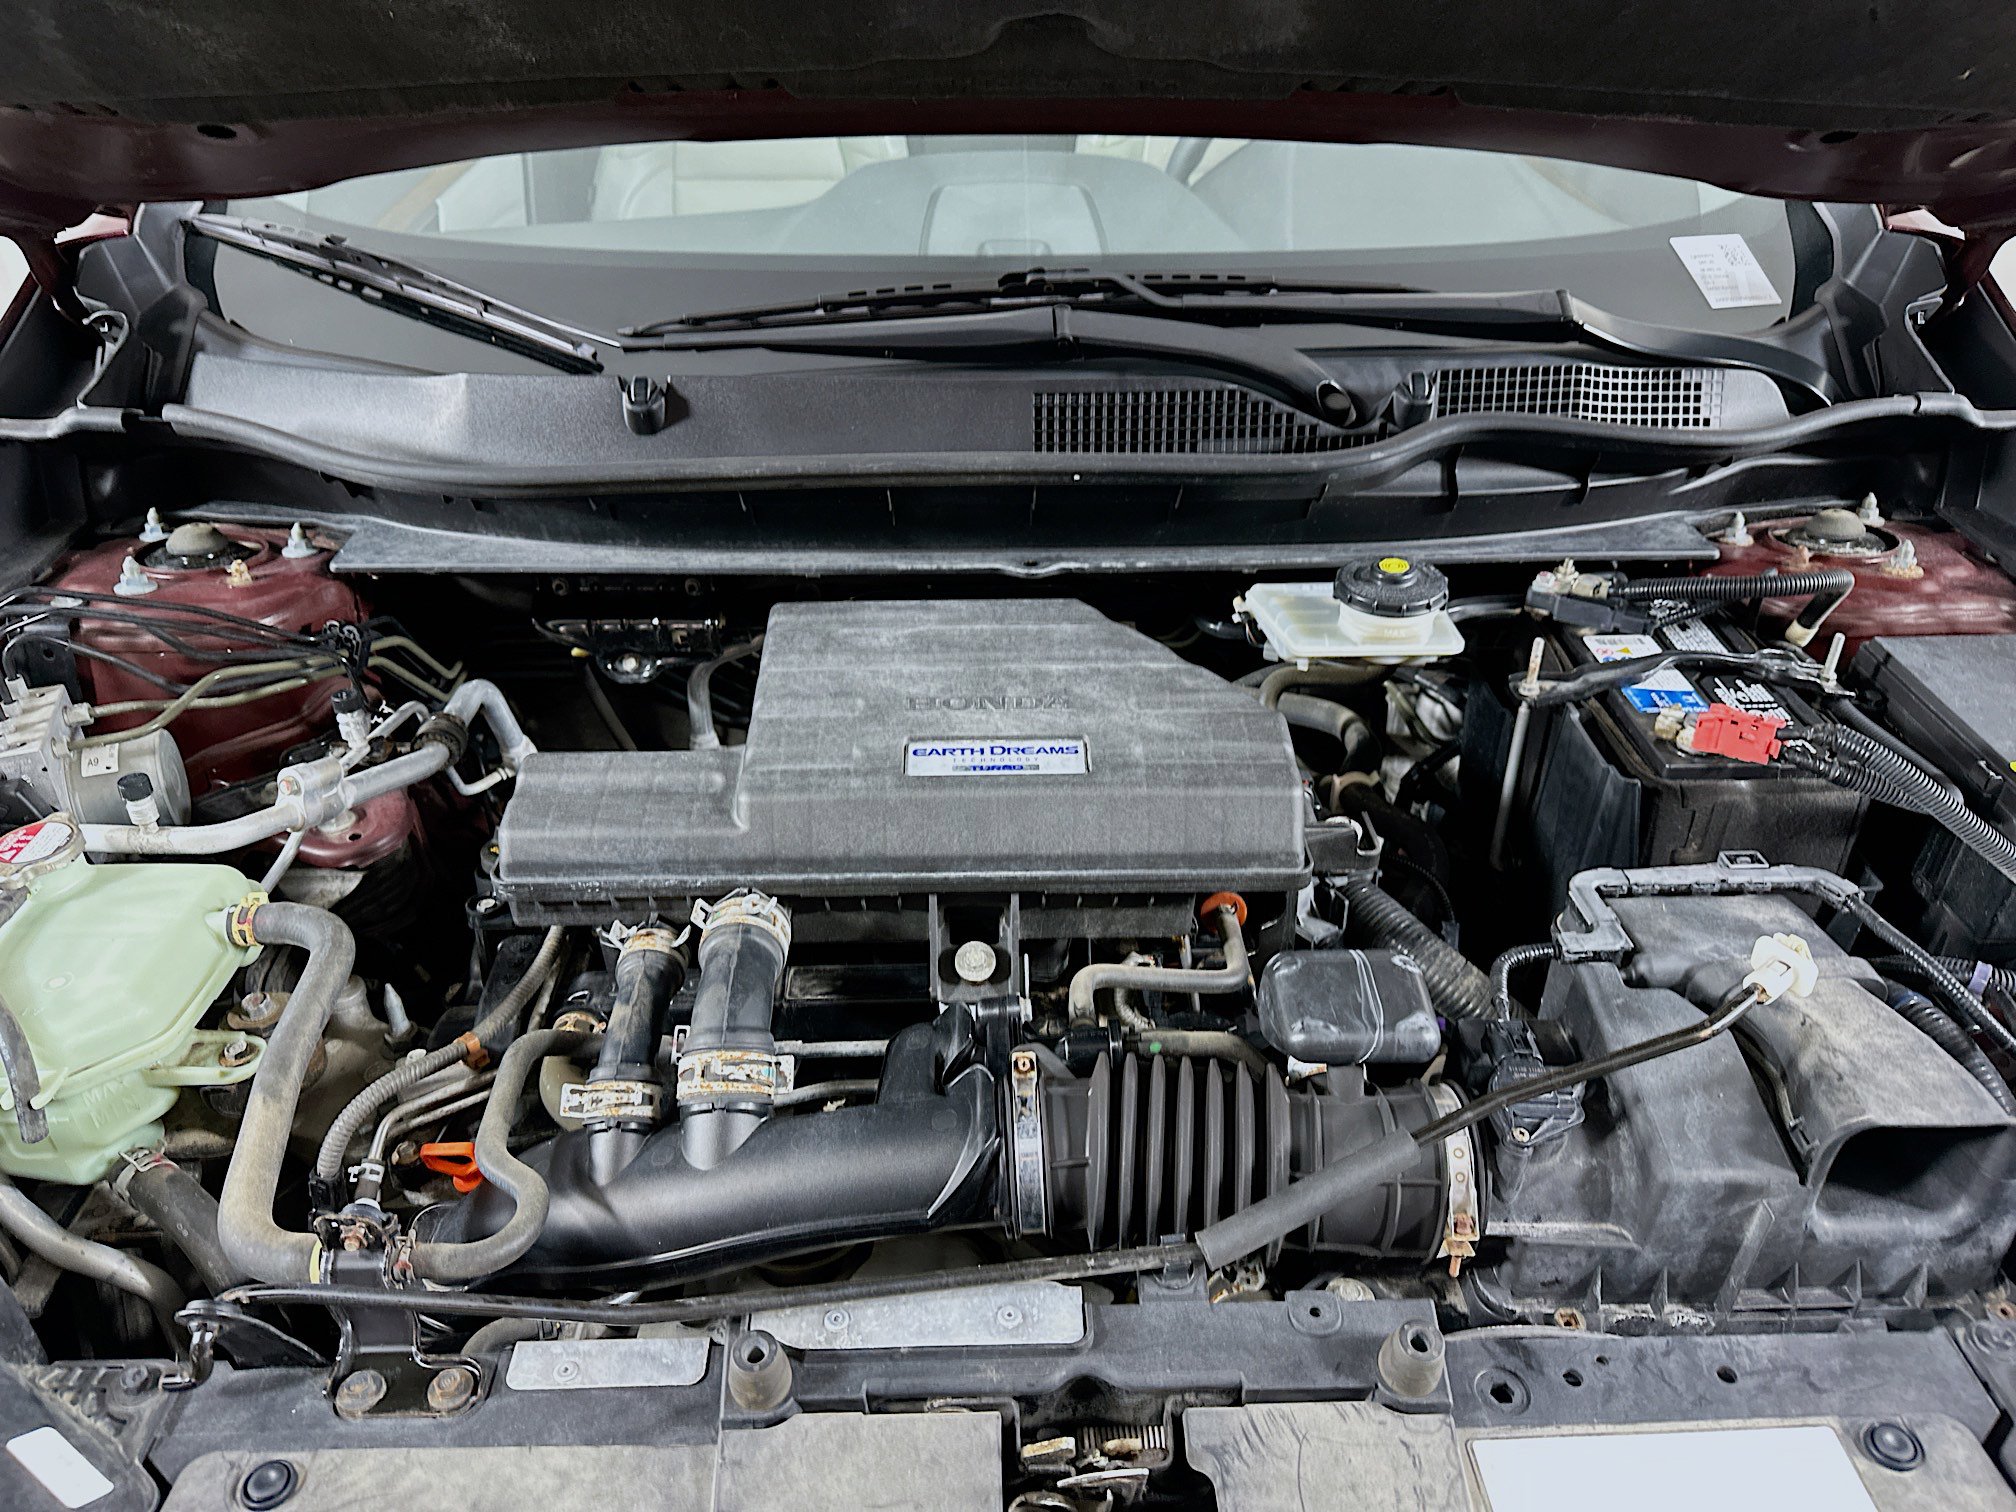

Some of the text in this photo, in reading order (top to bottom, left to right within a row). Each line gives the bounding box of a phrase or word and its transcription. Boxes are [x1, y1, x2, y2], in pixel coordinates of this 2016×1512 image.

[907, 696, 1070, 710] HONDA
[912, 745, 1079, 757] EARTH DREAMS
